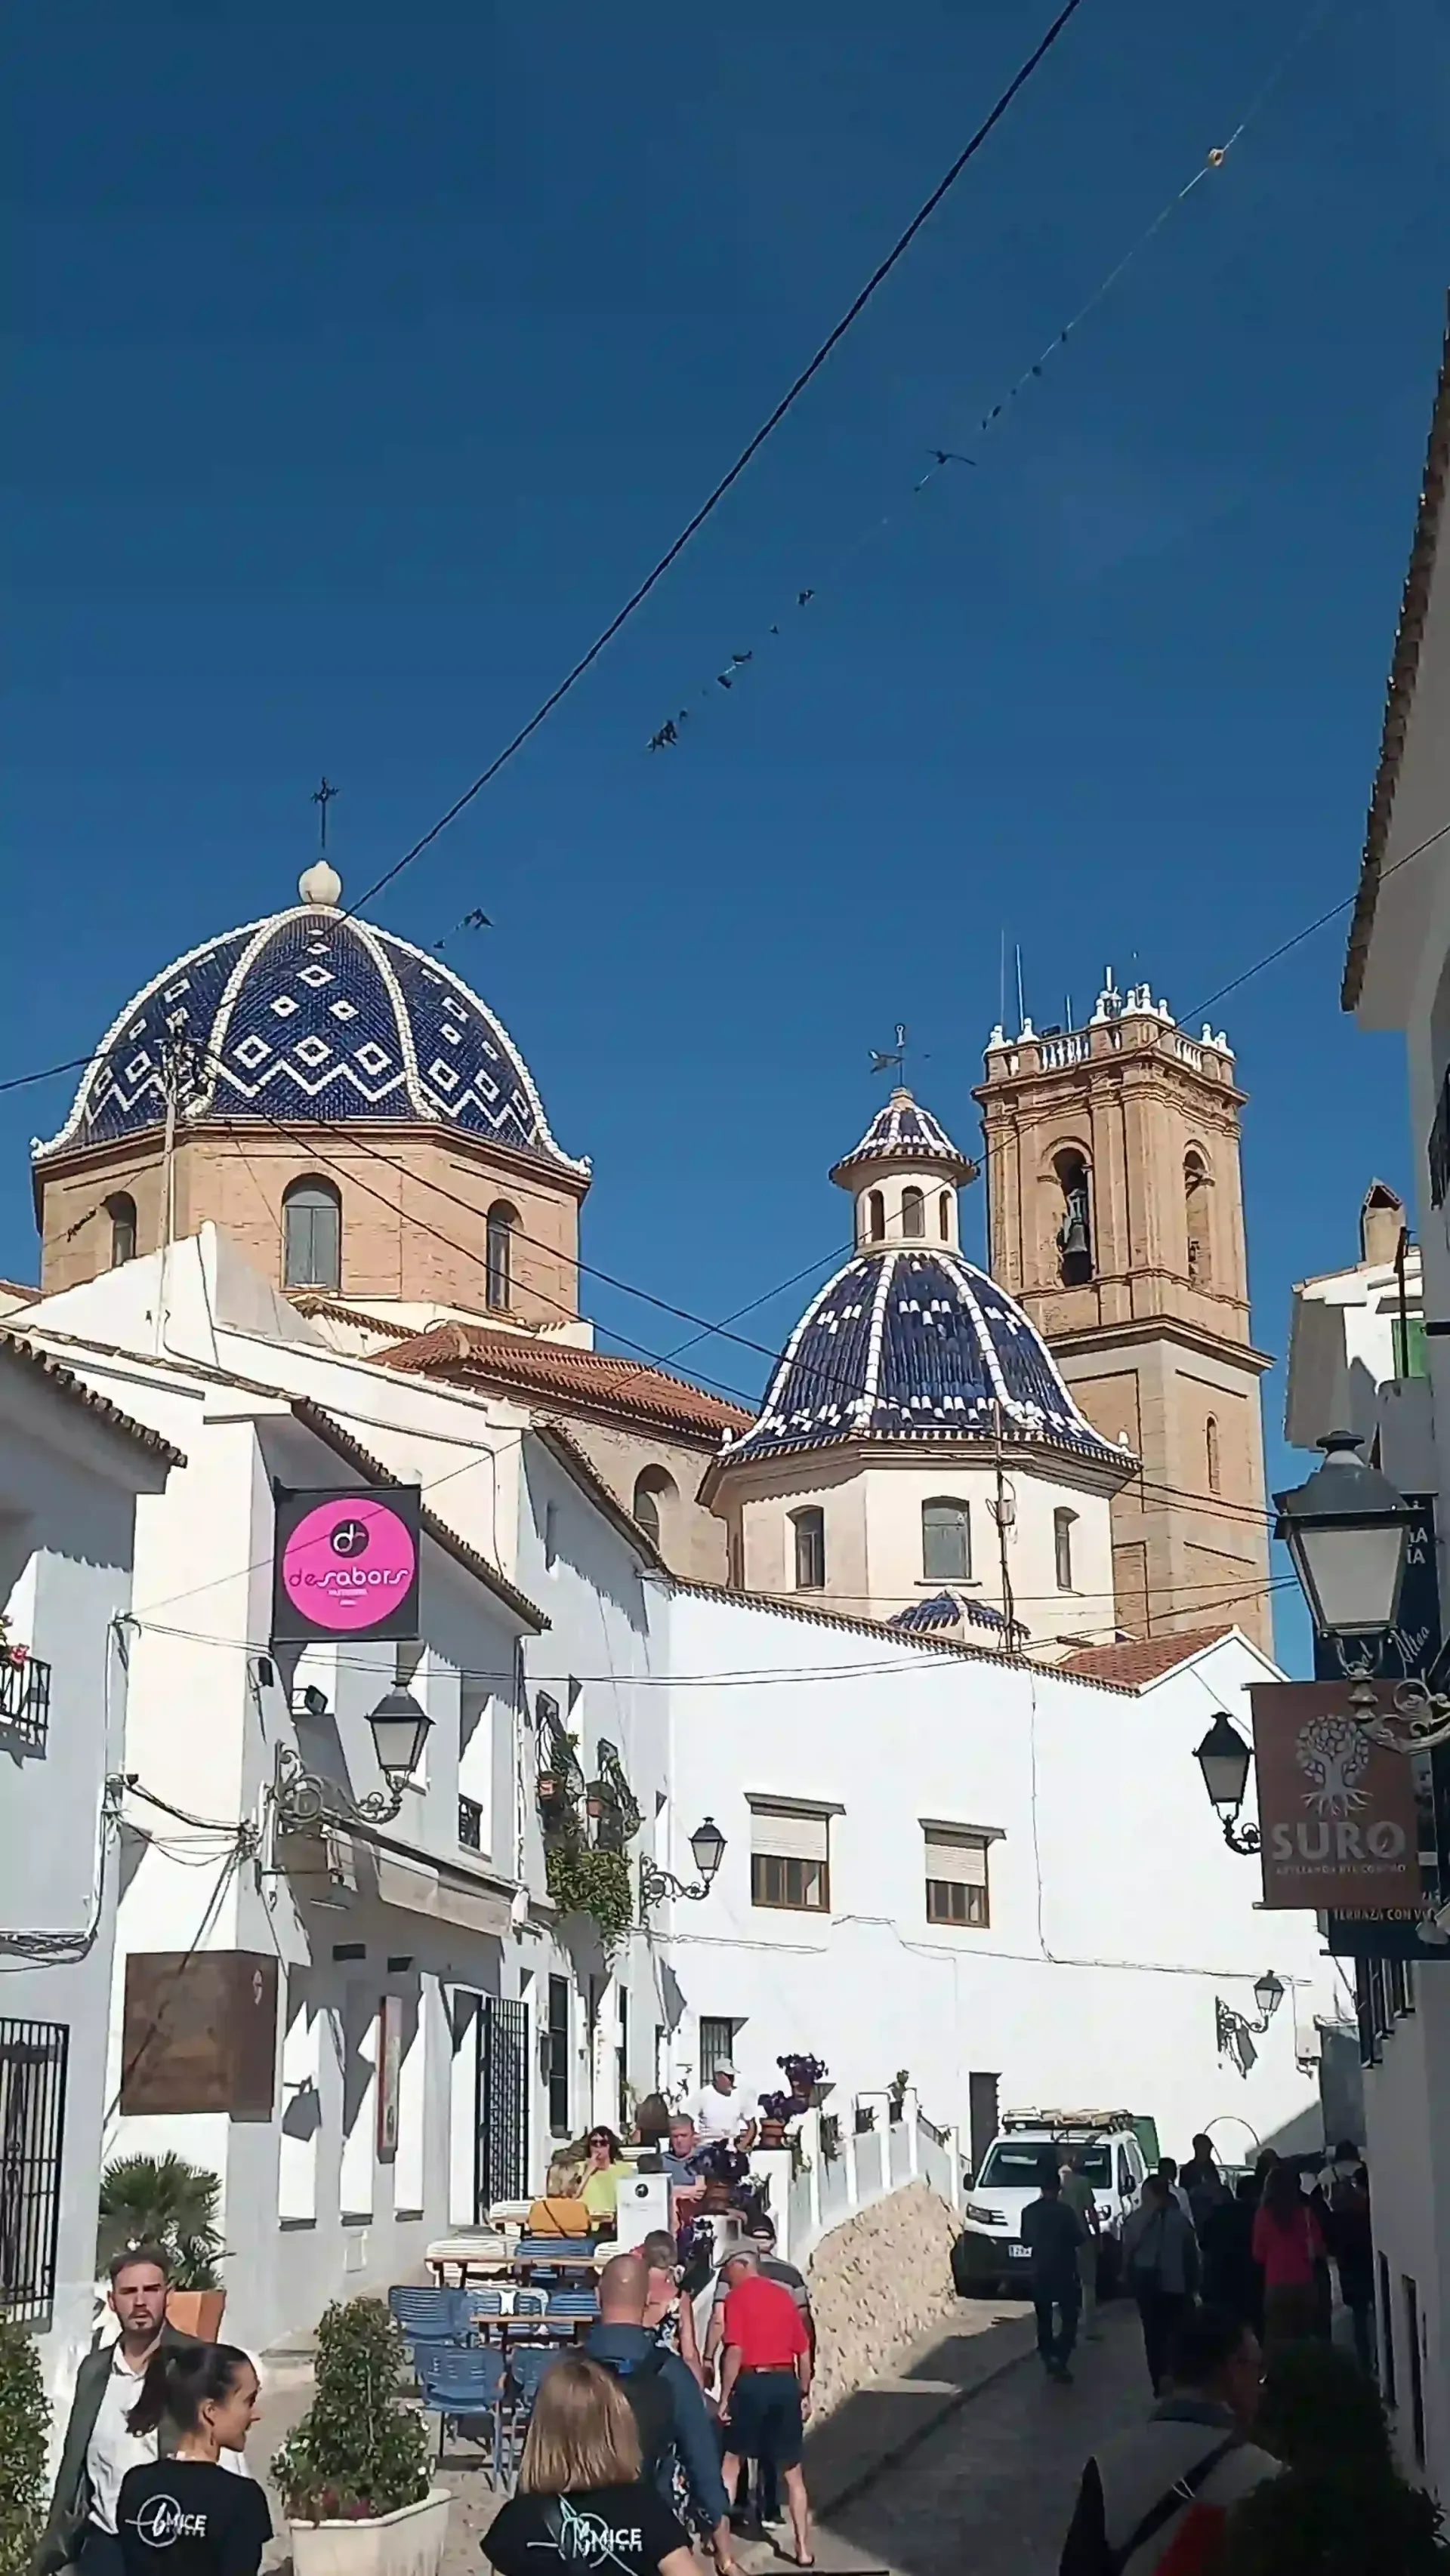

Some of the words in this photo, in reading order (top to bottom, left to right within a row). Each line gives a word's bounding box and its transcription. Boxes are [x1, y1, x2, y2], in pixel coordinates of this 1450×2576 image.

[1272, 1820, 1406, 1860] SURO
[1387, 1908, 1411, 1921] CON
[166, 2510, 207, 2531] MICE
[591, 2528, 642, 2545] MICE
